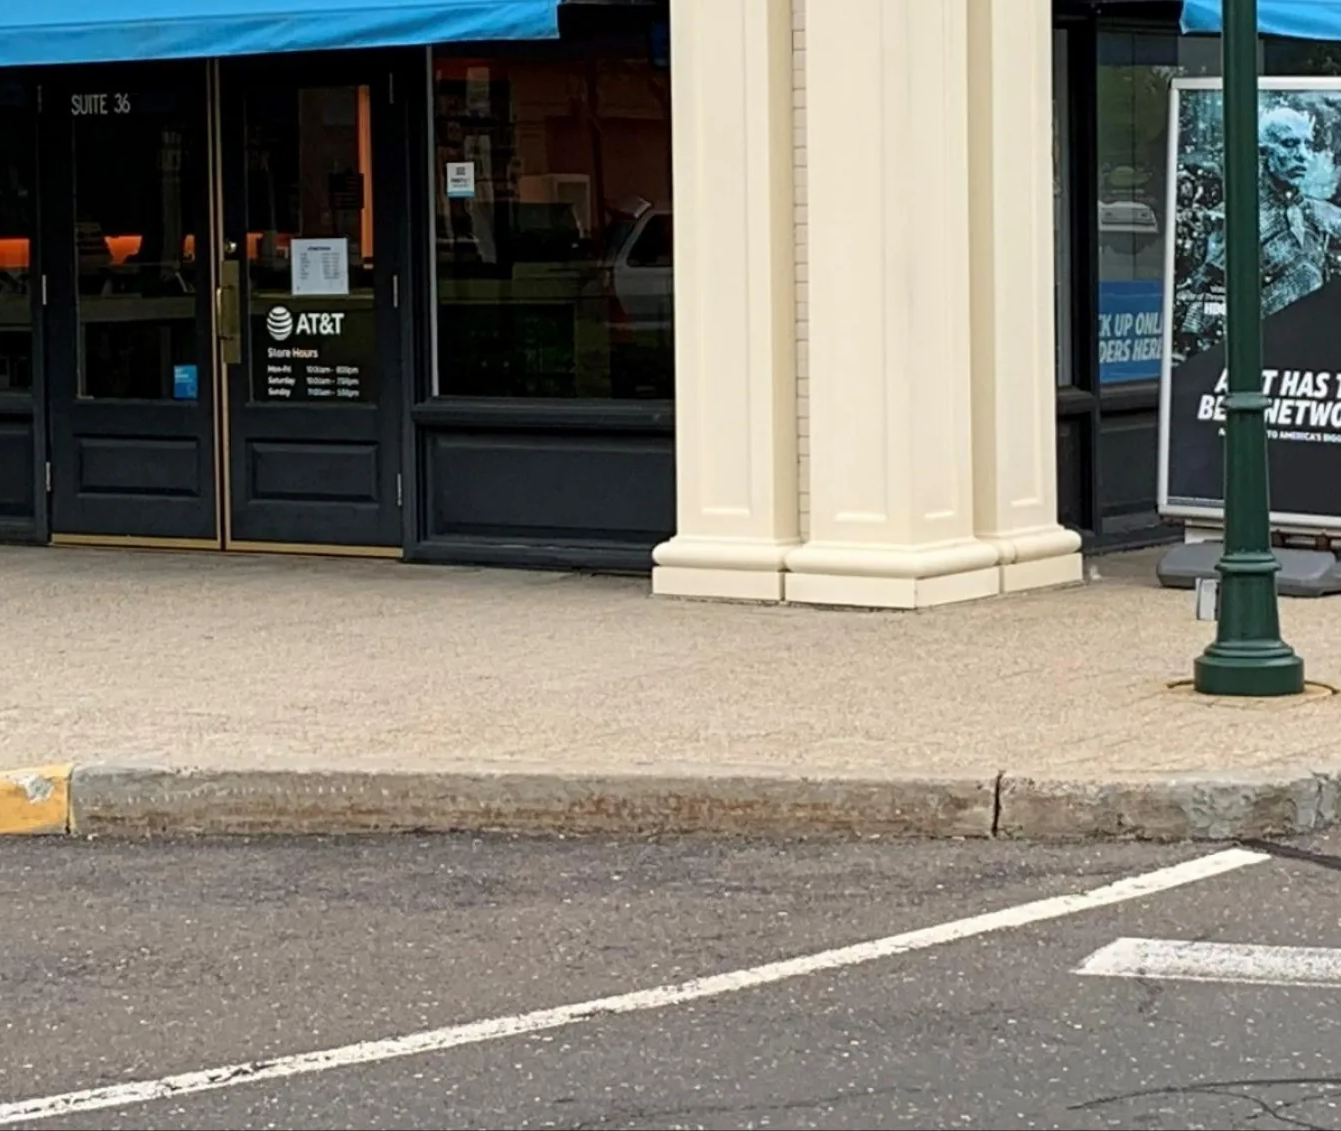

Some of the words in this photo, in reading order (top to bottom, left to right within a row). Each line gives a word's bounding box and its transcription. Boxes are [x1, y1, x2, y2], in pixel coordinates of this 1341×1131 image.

[71, 93, 109, 116] SUITE
[114, 92, 131, 114] 36
[296, 312, 345, 336] AT&T
[1114, 312, 1134, 338] UP
[1135, 311, 1164, 336] ONL
[267, 347, 291, 359] Store
[292, 347, 319, 359] Hours
[1099, 338, 1132, 364] DERS
[1214, 368, 1279, 395] AT
[1279, 371, 1330, 398] HAS
[1197, 394, 1228, 421] BE
[1267, 429, 1279, 439] TO
[1279, 430, 1321, 442] AMERICA'S
